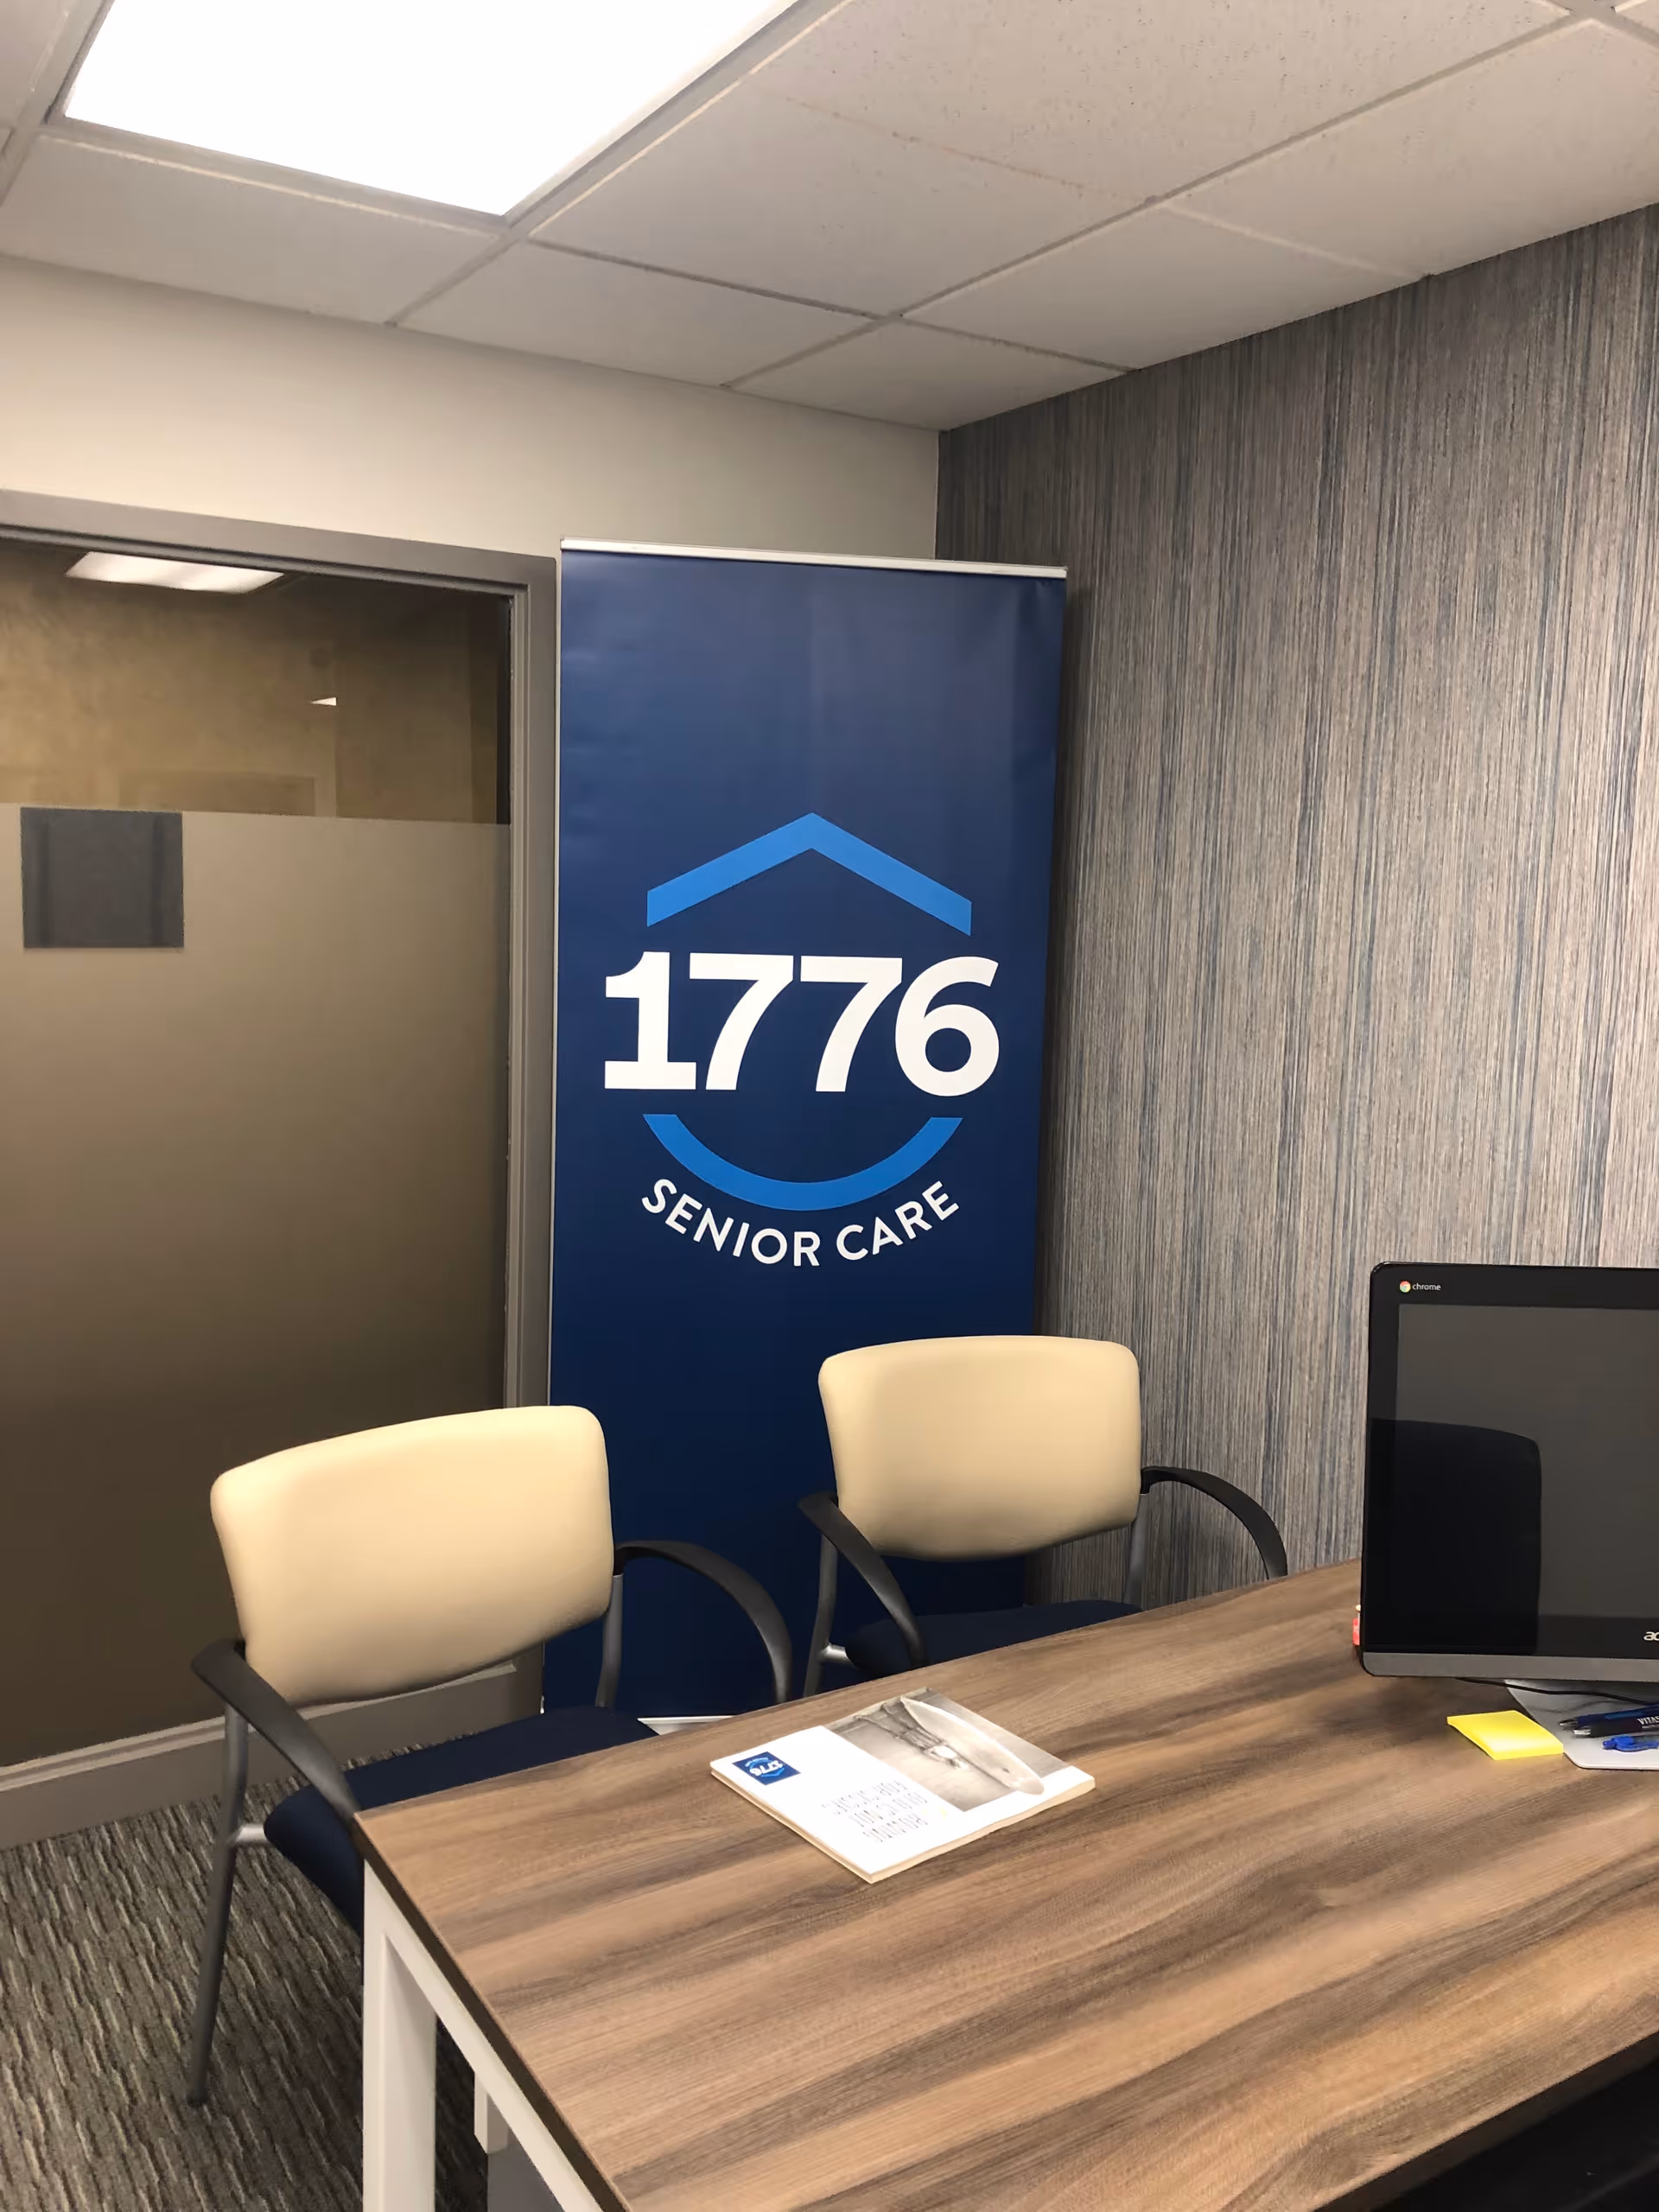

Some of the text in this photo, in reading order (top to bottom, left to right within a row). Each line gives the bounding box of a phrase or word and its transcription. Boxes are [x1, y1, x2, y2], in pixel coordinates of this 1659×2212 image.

[604, 950, 1000, 1097] 1776
[642, 1179, 960, 1268] SENIOR CARE
[1412, 1282, 1441, 1291] chrome
